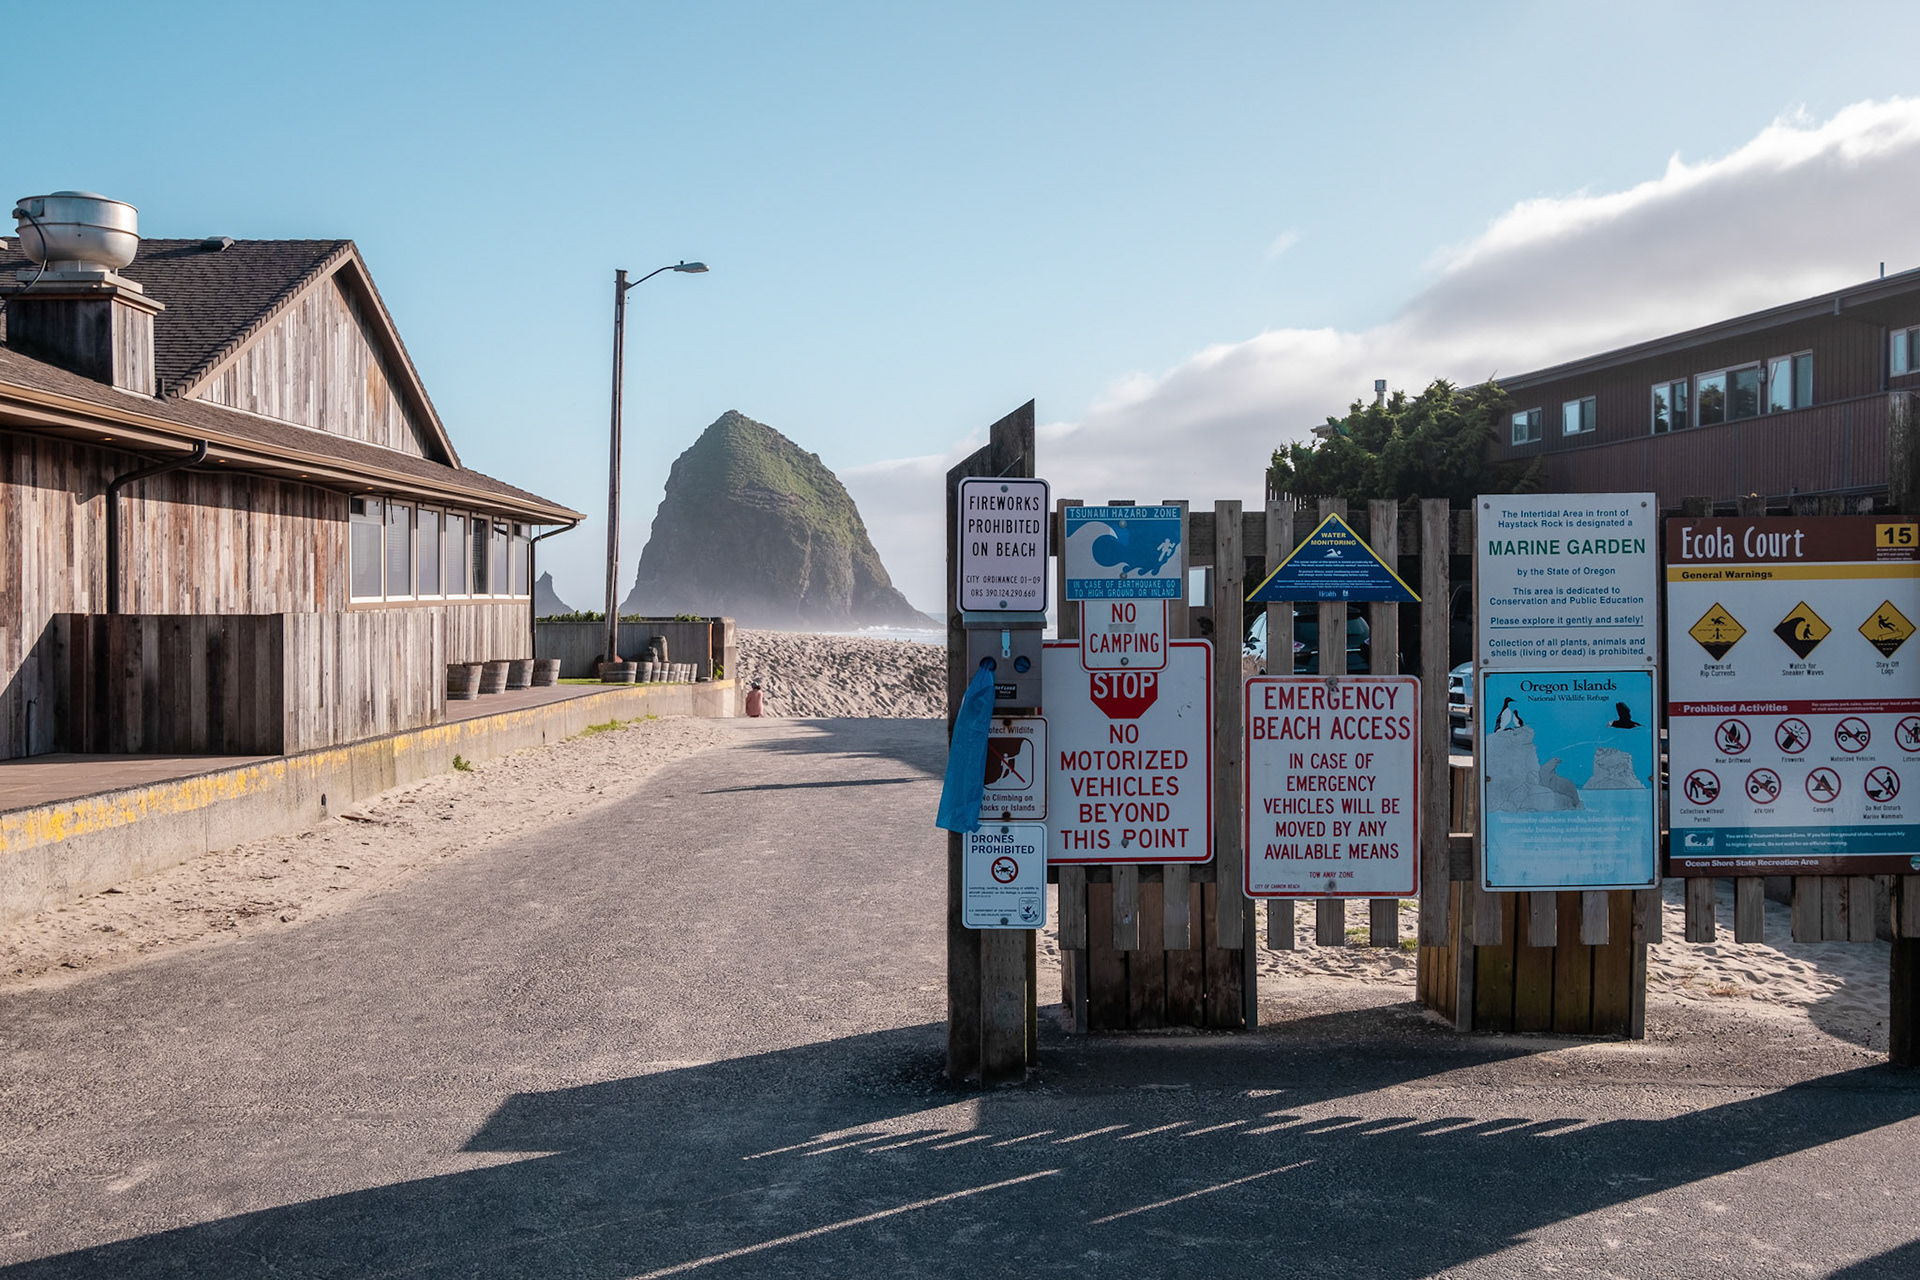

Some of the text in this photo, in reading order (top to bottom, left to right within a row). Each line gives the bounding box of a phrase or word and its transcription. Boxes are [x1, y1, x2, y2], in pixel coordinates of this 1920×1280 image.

[970, 497, 1039, 510] FIREWORKS
[1070, 508, 1177, 518] TSUNAMI HAZARD ZONE
[969, 520, 1039, 533] PROHIBITED
[1498, 520, 1538, 529] Haystack
[1577, 519, 1624, 528] designated
[1682, 526, 1804, 558] Ecola Court
[1884, 528, 1912, 544] 15
[973, 542, 1035, 557] ON BEACH
[1489, 539, 1645, 555] MARINE GARDEN
[1517, 568, 1527, 577] by
[1584, 567, 1615, 576] Oregon
[1725, 570, 1772, 579] Warnings
[1108, 589, 1134, 597] GROUND
[1152, 588, 1174, 596] INLAND
[1112, 603, 1136, 622] NO
[1522, 617, 1554, 626] explore
[1566, 616, 1592, 626] gently
[1614, 616, 1643, 625] safely!
[1090, 633, 1159, 653] CAMPING
[1561, 639, 1590, 648] plants,
[1520, 649, 1546, 658] (living
[1562, 649, 1585, 657] dead)
[1599, 648, 1645, 657] prohibited.
[1093, 673, 1154, 698] STOP
[1521, 679, 1616, 694] Oregon Islands
[1265, 687, 1398, 709] EMERGENCY
[1110, 724, 1138, 743] NO
[1253, 716, 1410, 740] BEACH ACCESS
[1060, 750, 1187, 770] MOTORIZED
[1290, 753, 1374, 769] IN CASE OF
[1071, 777, 1178, 796] VEHICLES
[1287, 776, 1376, 791] EMERGENCY
[992, 794, 1022, 803] Climbing
[1264, 798, 1400, 814] VEHICLES WILL BE
[1080, 803, 1169, 823] BEYOND
[1276, 821, 1387, 837] MOVED BY ANY
[972, 835, 1014, 843] DRONES
[1060, 828, 1189, 849] THIS POINT
[972, 846, 1034, 854] PROHIBITED
[1265, 844, 1398, 859] AVAILABLE MEANS
